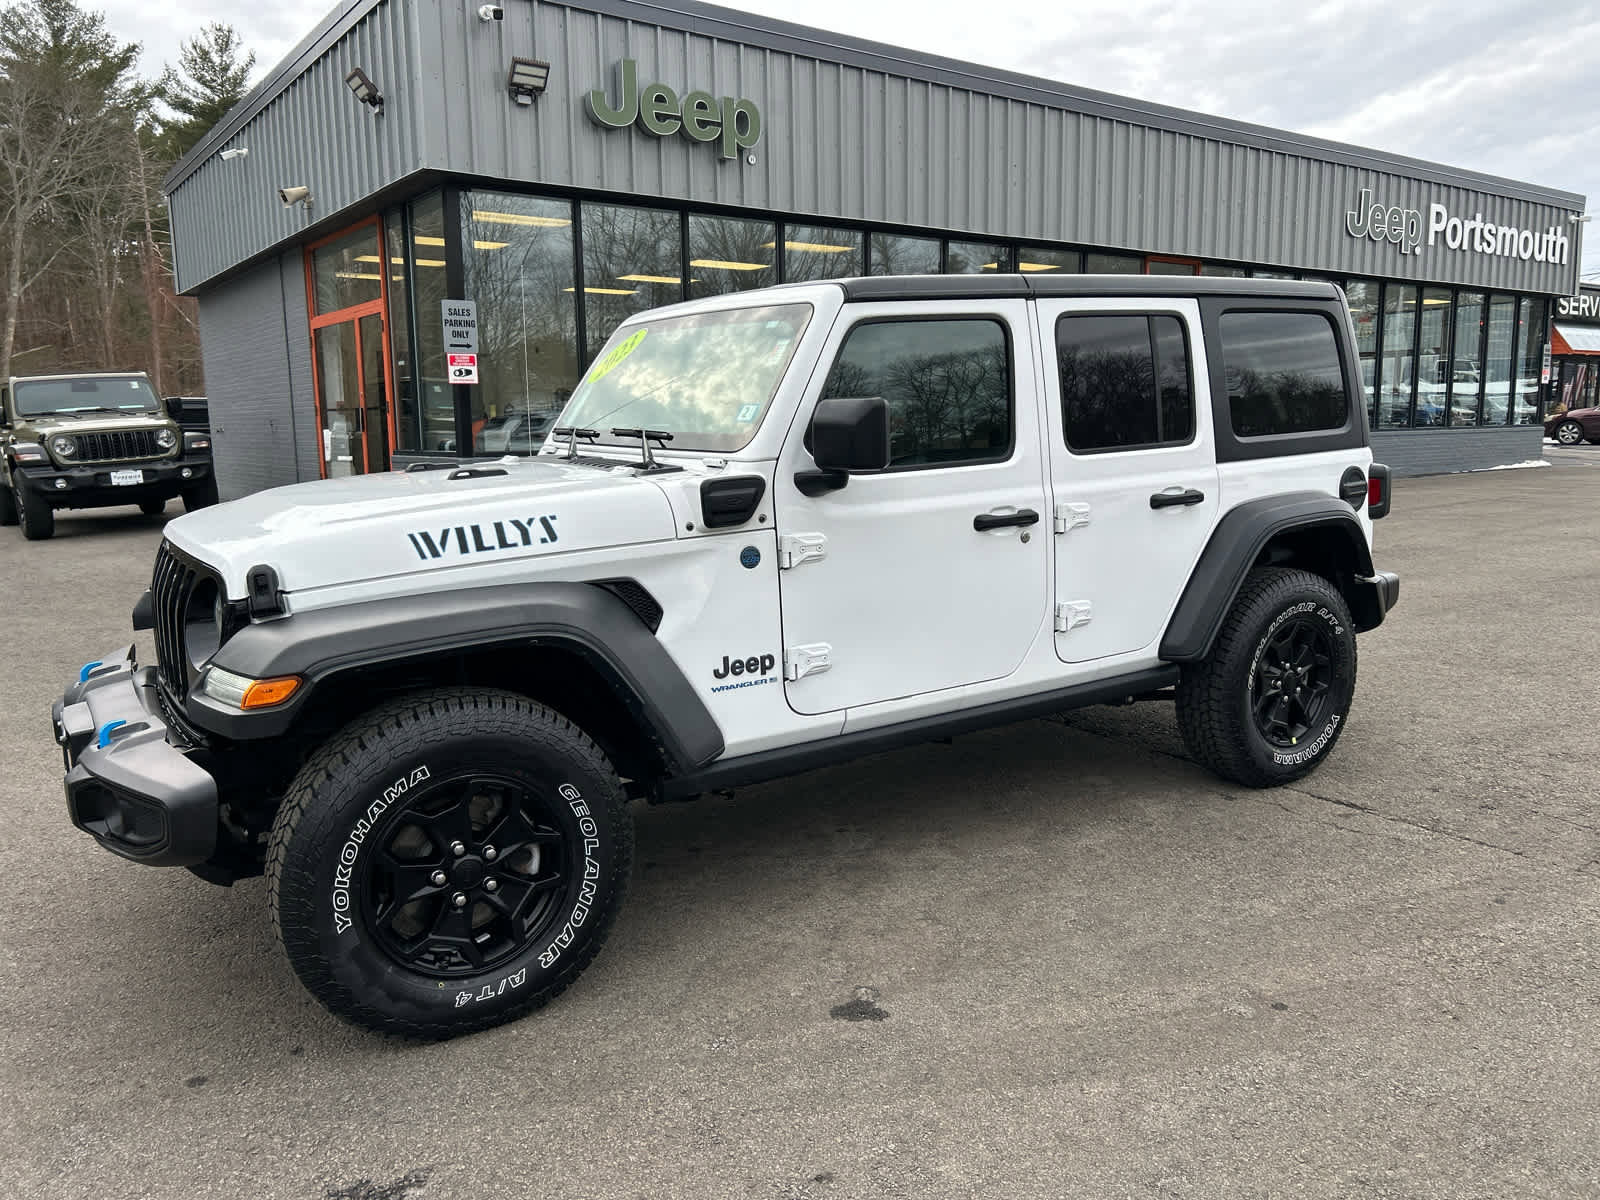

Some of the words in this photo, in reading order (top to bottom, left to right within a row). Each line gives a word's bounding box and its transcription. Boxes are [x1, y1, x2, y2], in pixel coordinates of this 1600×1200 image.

[587, 58, 761, 160] Jeep
[1347, 188, 1422, 254] Jeep
[1428, 202, 1568, 265] Portsmouth
[444, 318, 476, 328] PARKING
[447, 307, 471, 317] SALES
[1558, 294, 1600, 318] SERV
[451, 329, 470, 339] ONLY
[407, 514, 558, 560] WILLYS
[713, 653, 775, 680] Jeep
[710, 678, 768, 693] WRANGLER
[1273, 713, 1341, 766] YOKOHAMA
[332, 764, 431, 935] YOKOHAMA
[537, 782, 600, 969] GEOLANDAR
